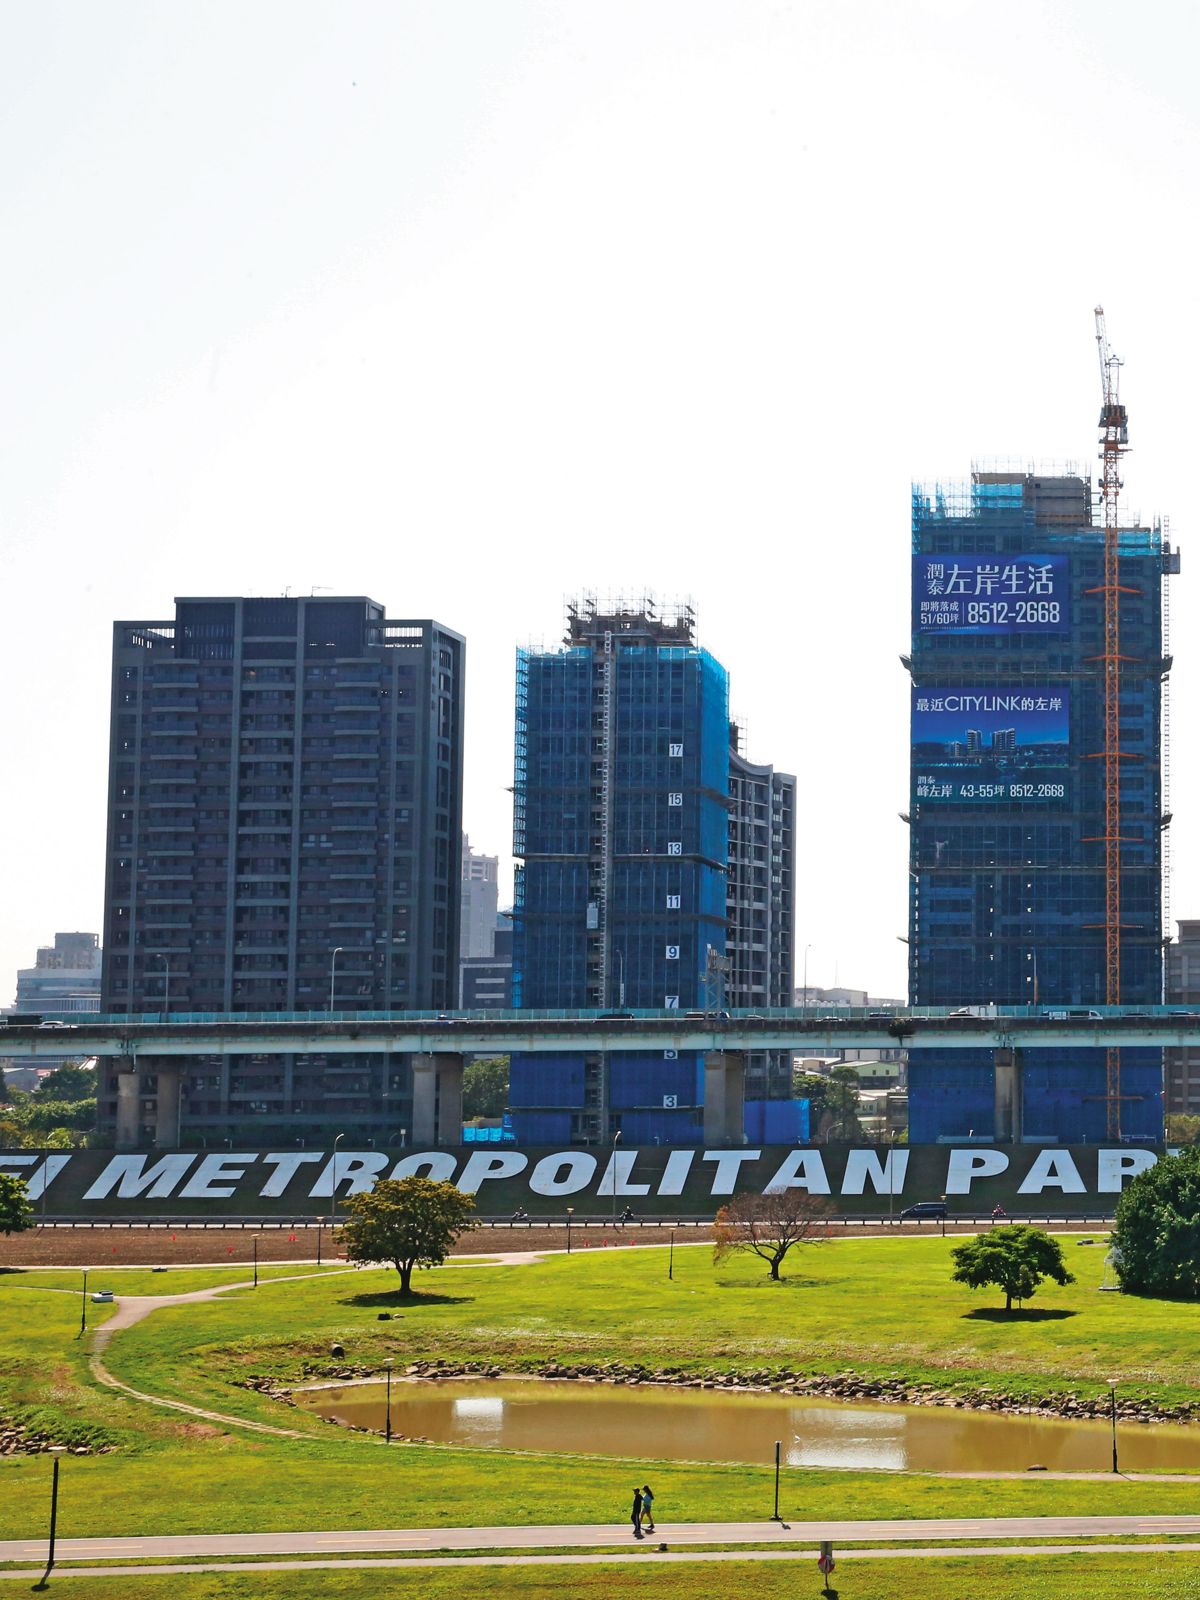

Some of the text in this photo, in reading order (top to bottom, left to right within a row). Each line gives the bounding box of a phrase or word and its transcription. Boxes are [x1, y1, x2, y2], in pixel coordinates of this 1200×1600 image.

[926, 563, 945, 595] 潤泰
[944, 564, 1053, 595] 左岸生活
[920, 601, 959, 612] 即將落成
[920, 613, 959, 625] 51/60坪
[967, 602, 1060, 624] 8512-2668
[916, 696, 1062, 712] 最近CITYLINK的左岸
[671, 745, 682, 756] 17
[918, 776, 935, 785] 潤泰
[917, 785, 1064, 798] 峰左岸 43-55坪 8512-2668
[670, 794, 682, 805] 15
[669, 843, 681, 854] 13
[668, 896, 680, 908] 11
[668, 947, 678, 958] 9
[666, 997, 677, 1009] 7
[665, 1096, 675, 1108] 3
[82, 1150, 909, 1200] METROPOLITAN
[946, 1148, 1180, 1195] PAR
